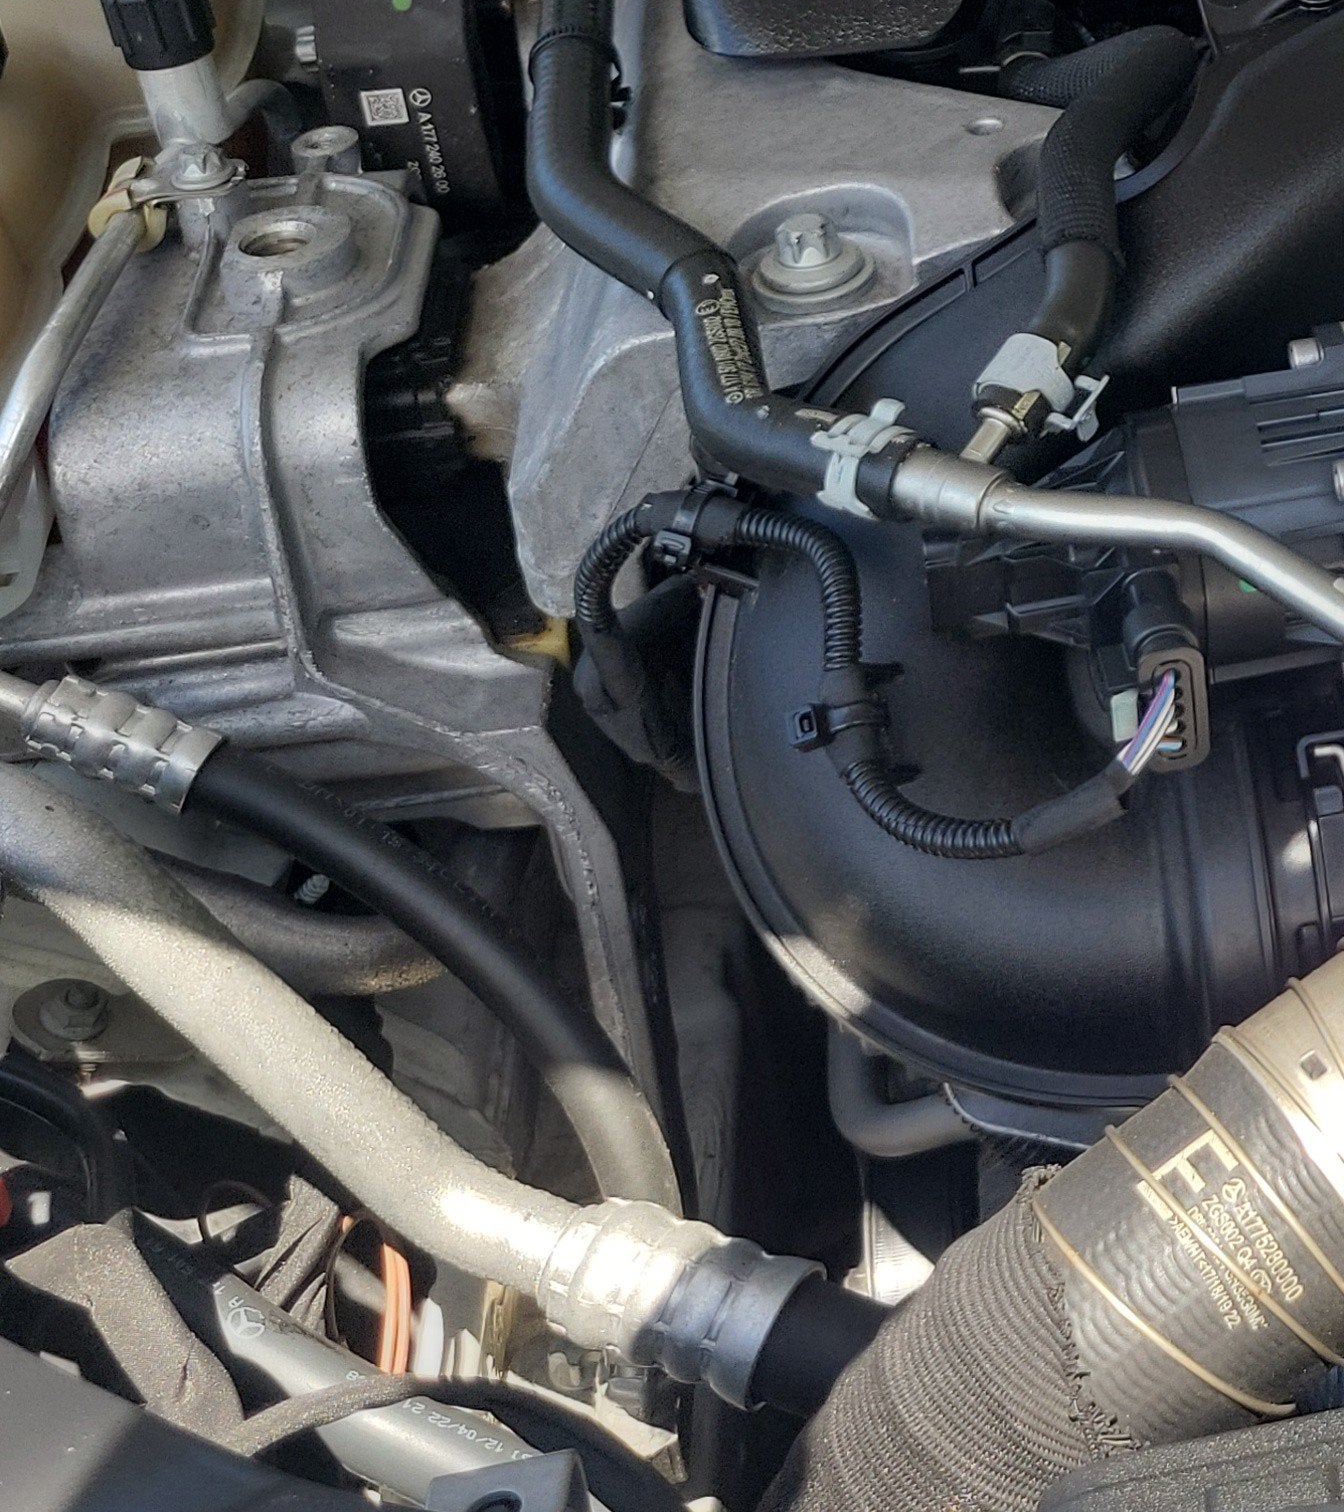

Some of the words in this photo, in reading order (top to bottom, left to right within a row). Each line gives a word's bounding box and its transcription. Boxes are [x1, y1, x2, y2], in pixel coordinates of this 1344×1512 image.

[1201, 1194, 1245, 1247] ZGS002
[1234, 1201, 1305, 1302] A1775280000
[427, 1409, 504, 1452] 12/04/22
